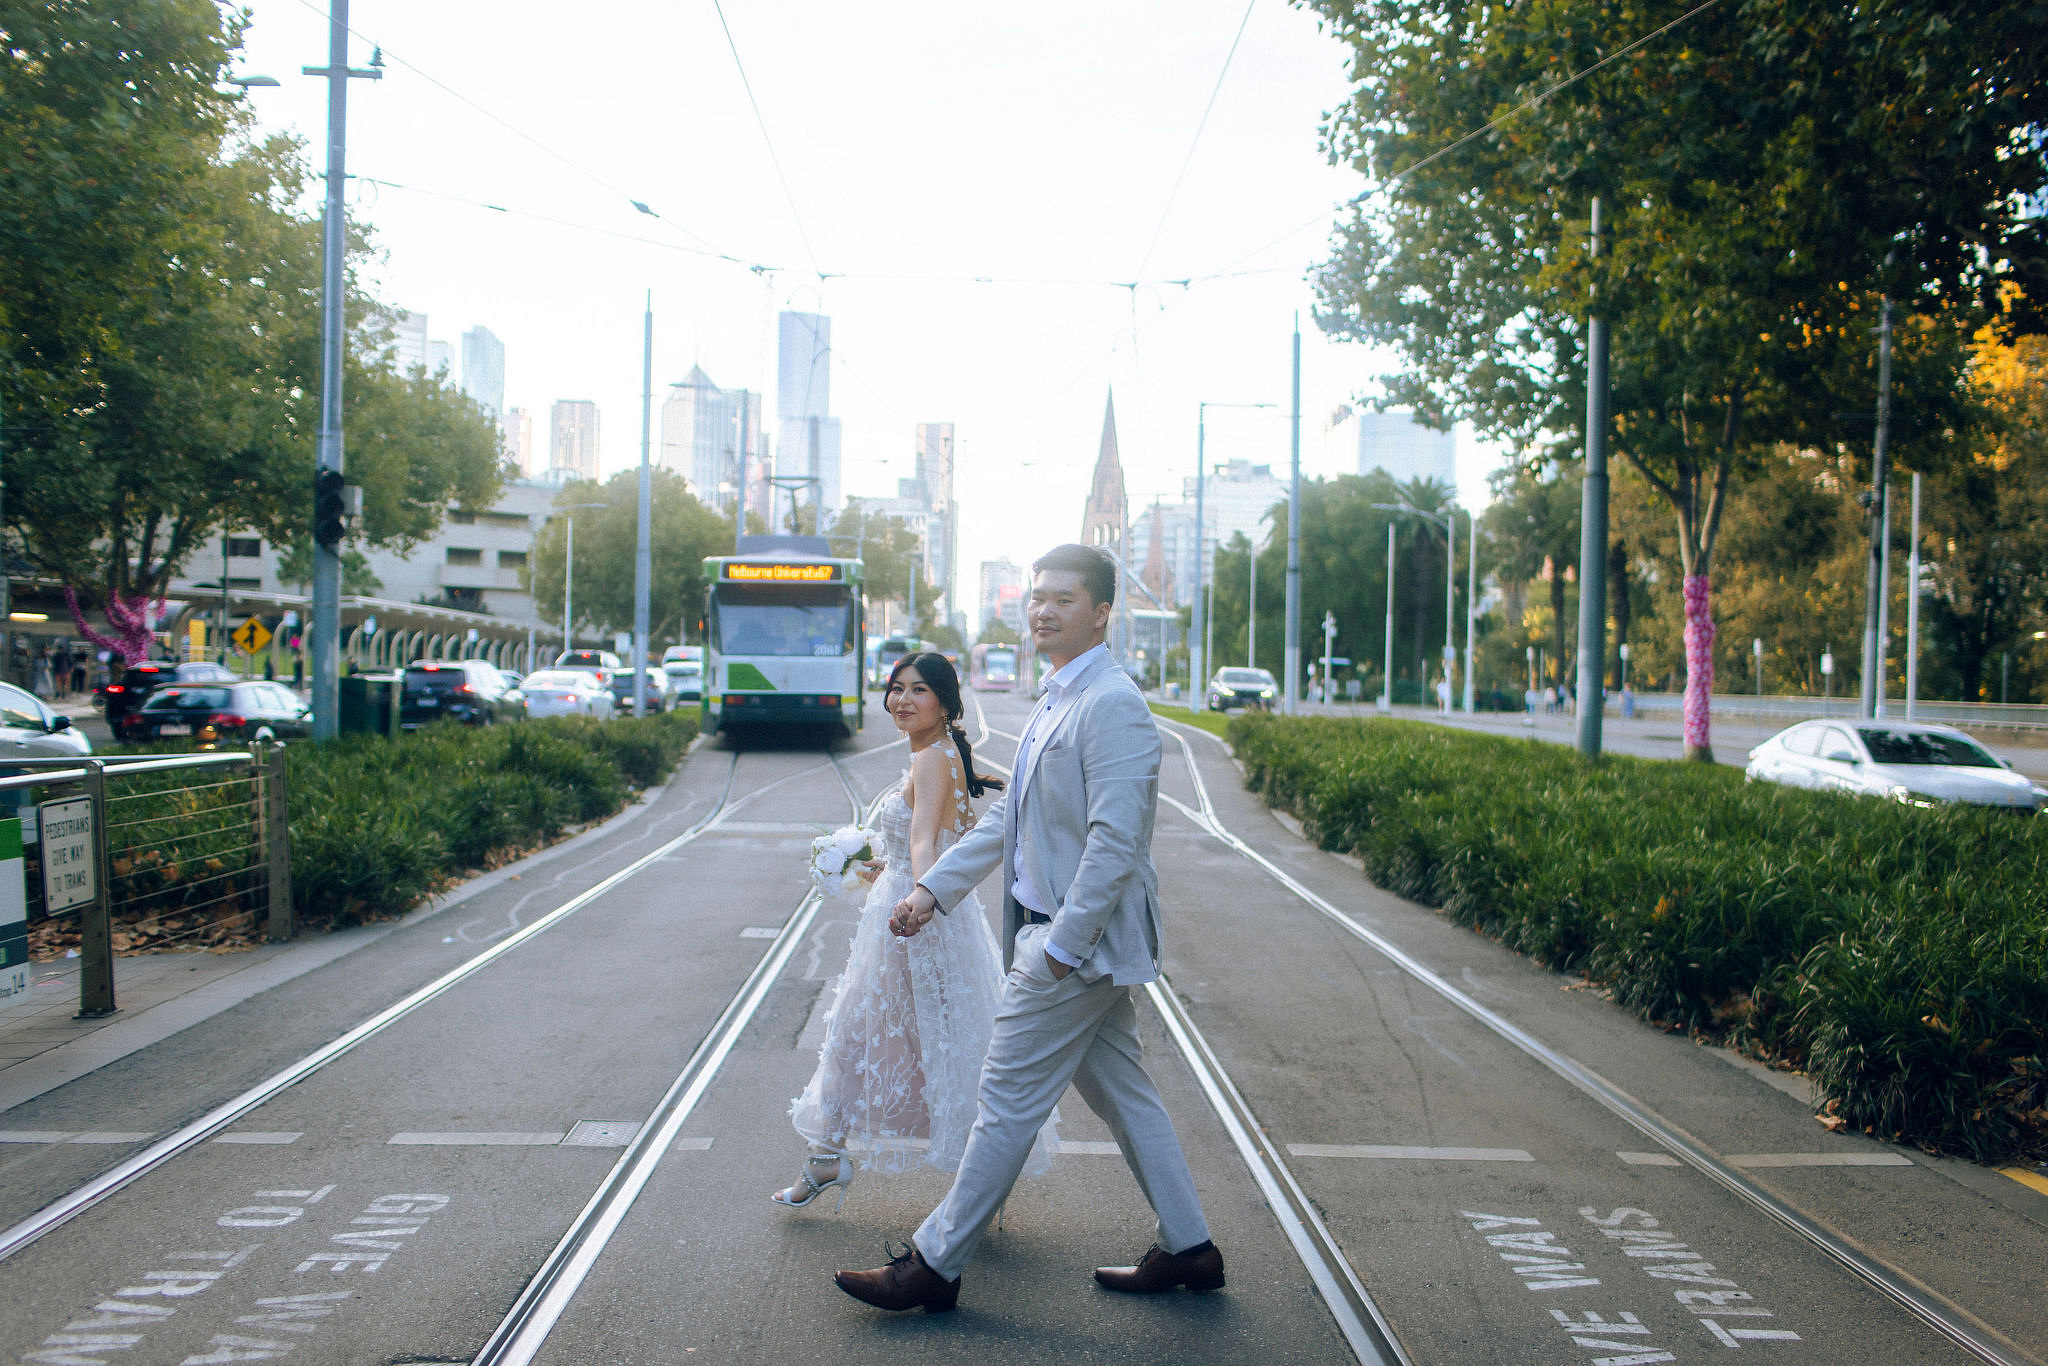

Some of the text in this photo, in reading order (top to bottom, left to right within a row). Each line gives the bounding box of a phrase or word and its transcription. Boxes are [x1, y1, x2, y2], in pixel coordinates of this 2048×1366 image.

[729, 565, 773, 579] Melbourne
[45, 816, 90, 840] PEDESTRIANS
[53, 844, 84, 866] GIVE WAY
[53, 870, 87, 893] TO TRAMS
[11, 972, 26, 995] 14
[217, 1184, 338, 1228] TO
[293, 1193, 450, 1273] GIVE
[1460, 1209, 1602, 1291] WAY
[1578, 1206, 1802, 1348] TRAMS
